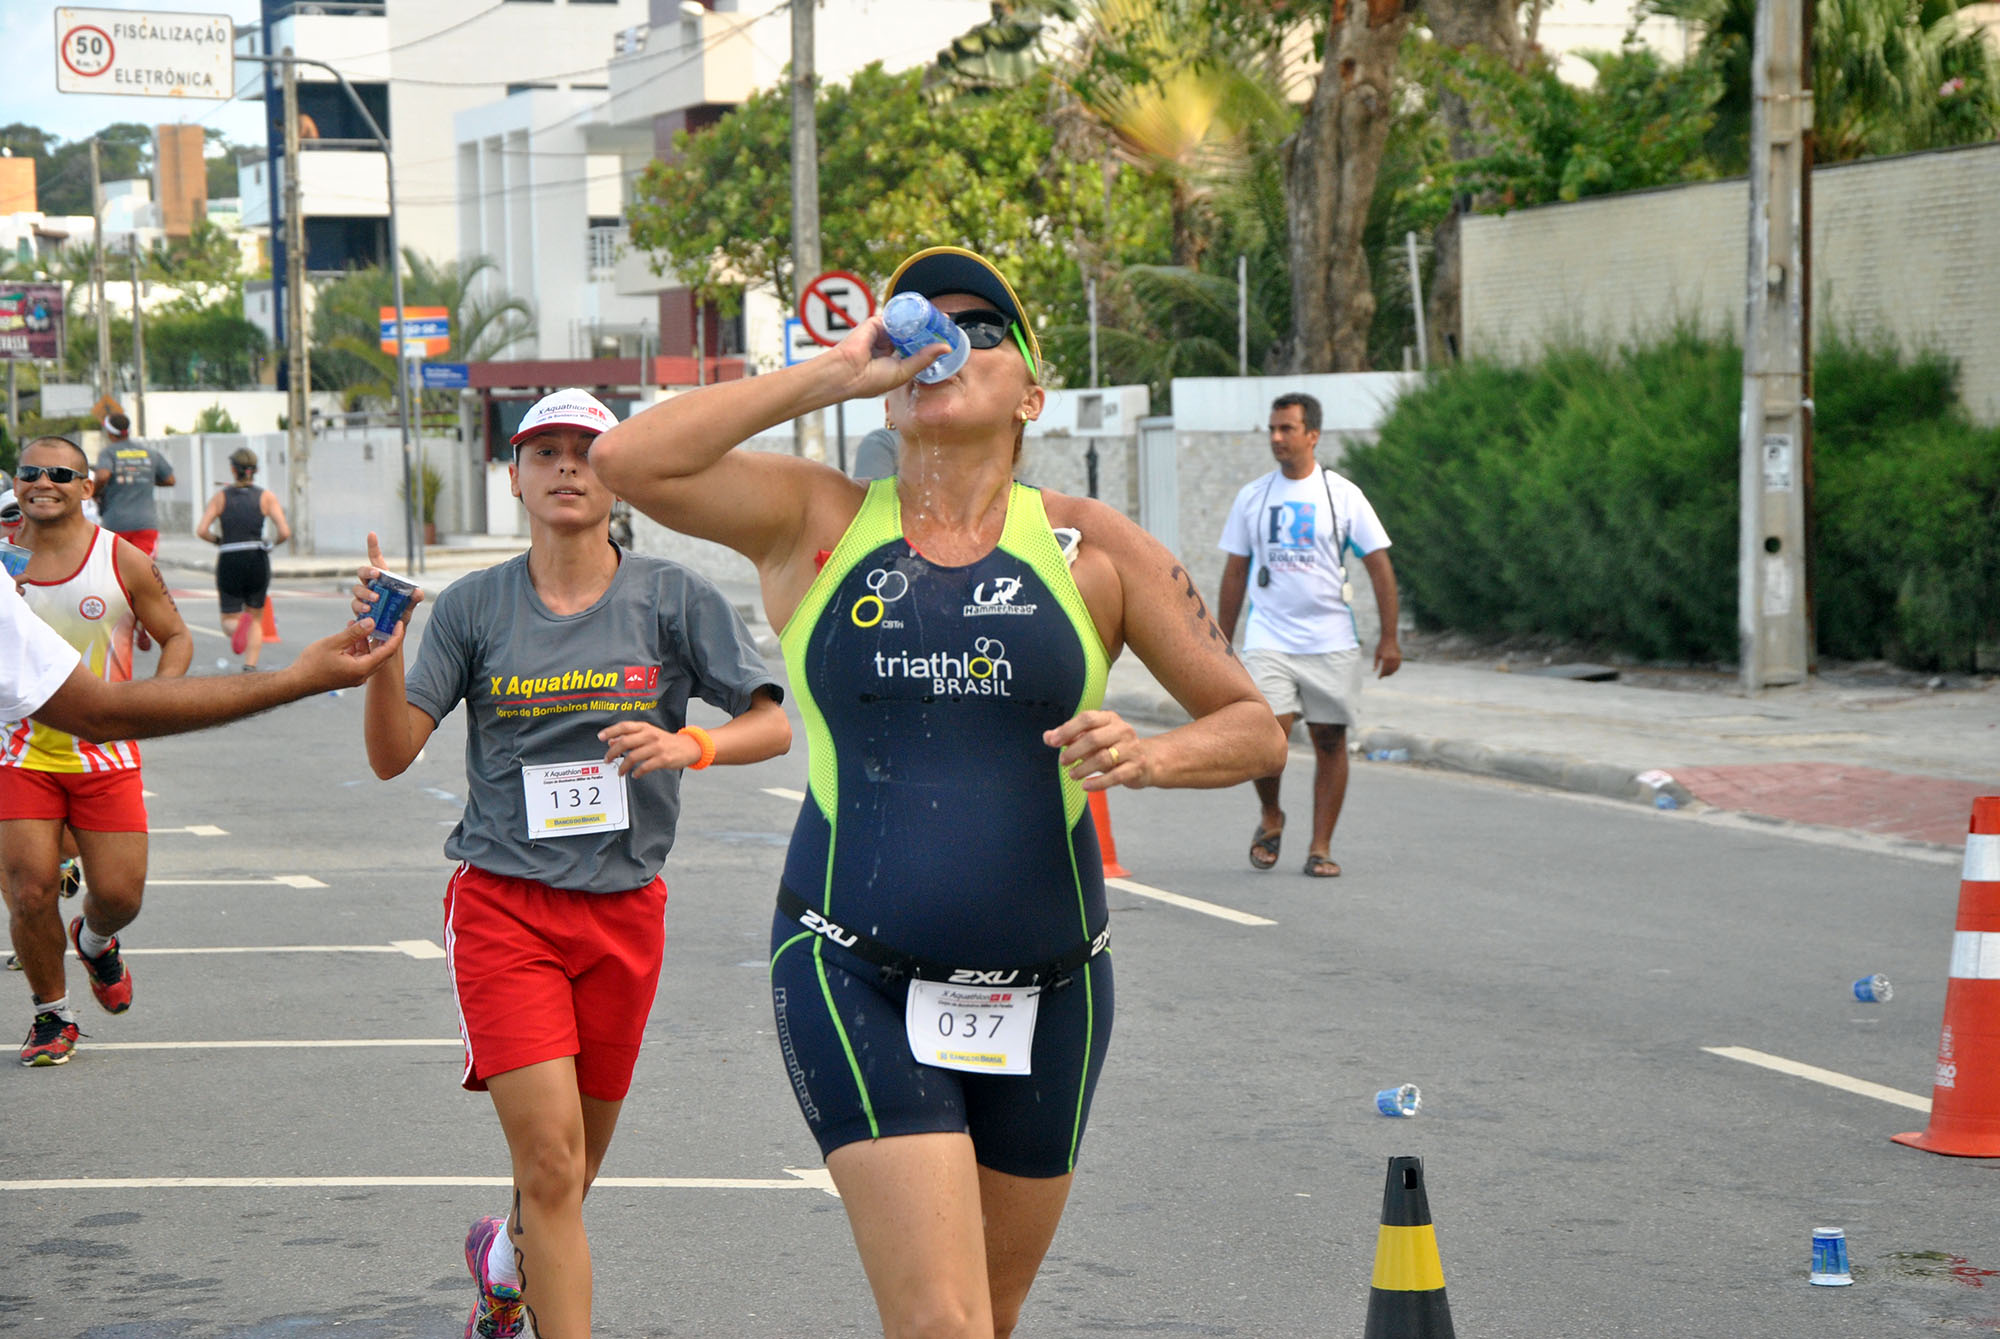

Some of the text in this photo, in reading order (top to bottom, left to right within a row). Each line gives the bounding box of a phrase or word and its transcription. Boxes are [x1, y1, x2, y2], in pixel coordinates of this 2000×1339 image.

[113, 23, 226, 45] FISCALIZAÇÃO
[76, 36, 103, 55] 50
[115, 67, 212, 86] ELETRÔNICA
[874, 650, 1013, 680] triathlon
[490, 669, 619, 699] X Aquathlon
[933, 678, 1011, 697] BRASIL
[520, 709, 531, 718] de
[533, 703, 588, 718] Bombeiros
[590, 700, 620, 712] Militar
[621, 701, 633, 712] da
[550, 767, 582, 777] Aquathlon
[550, 786, 602, 809] 132
[799, 908, 858, 947] 2XU
[948, 969, 1019, 985] 2XU
[938, 1011, 1004, 1039] 037
